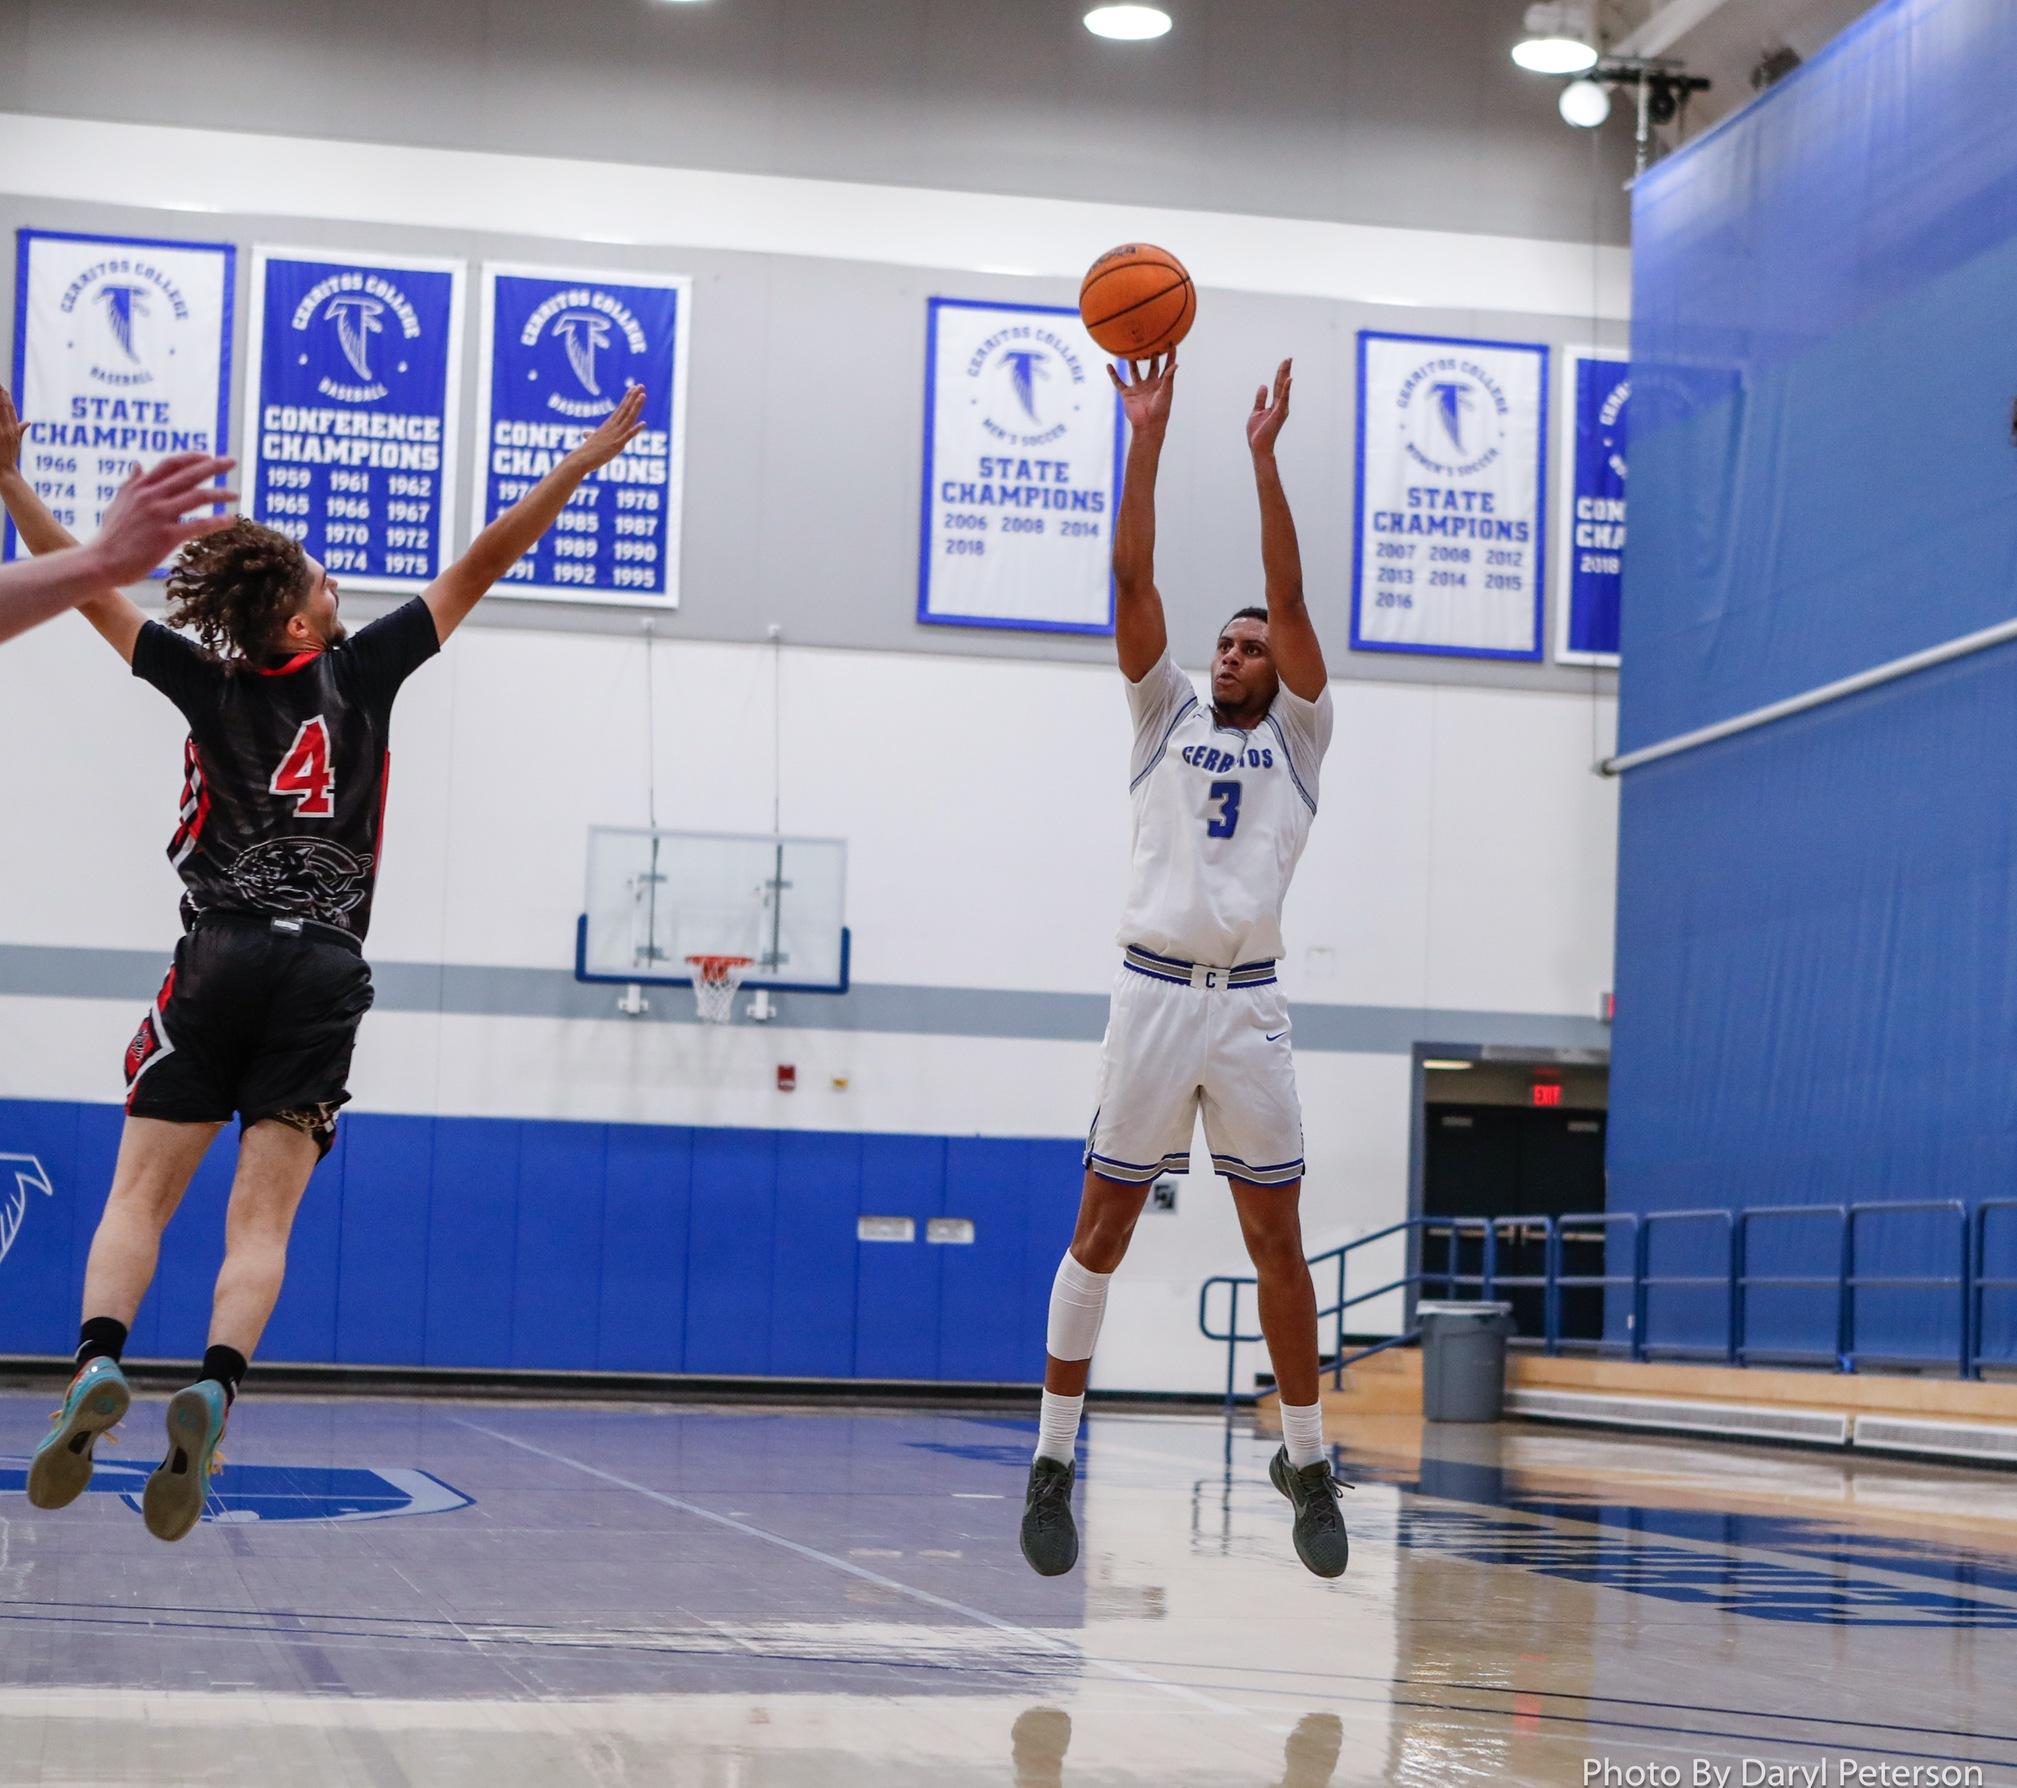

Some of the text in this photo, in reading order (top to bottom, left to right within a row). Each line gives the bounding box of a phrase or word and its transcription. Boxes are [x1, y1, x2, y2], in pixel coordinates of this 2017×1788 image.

[61, 260, 189, 320] CERRITOS COLLEGE
[292, 272, 421, 339] CERRITOS COLLEGE
[520, 288, 647, 354] CERRITOS COLLEGE
[967, 327, 1085, 385] CERRITOS COLLEGE
[90, 367, 153, 385] BASEBALL
[318, 375, 389, 402] BASEBALL
[1396, 359, 1508, 415] CERRITOS COLLEGE
[71, 397, 170, 424] STATE
[264, 405, 440, 441] CONFERENCE
[30, 422, 208, 452] CHAMPIONS
[981, 418, 1067, 447] MEN'S SOCCER
[36, 456, 77, 473] 1966
[262, 432, 440, 471] CHAMPIONS
[1405, 442, 1499, 477] WOMEN'S SOCCER
[268, 466, 431, 497] 1959 1961 1962
[979, 457, 1070, 483] STATE
[34, 481, 76, 498] 1974
[498, 480, 534, 501] 197
[616, 489, 659, 511] 1978
[941, 481, 1105, 513] CHAMPIONS
[1407, 487, 1495, 513] STATE
[266, 492, 430, 523] 1965 1966 1967
[1577, 497, 1627, 522] CON
[325, 522, 369, 545] 1970
[386, 527, 429, 549] 1972
[556, 511, 658, 536] 1985 1987
[944, 514, 1100, 538] 2006 2008 2014
[1373, 511, 1529, 542] CHAMPIONS
[554, 537, 598, 559] 1989
[614, 541, 657, 562] 1990
[945, 539, 985, 556] 2018
[1376, 543, 1522, 567] 2007 2008 2012
[324, 548, 428, 575] 1974 1975
[553, 563, 596, 584] 1992
[613, 567, 656, 588] 1995
[1377, 567, 1522, 591] 2013 2014 2015
[1376, 592, 1413, 609] 2016
[269, 714, 335, 818] 4
[1207, 780, 1243, 839] 3
[1206, 972, 1216, 988] C
[1533, 1084, 1562, 1106] EXIT
